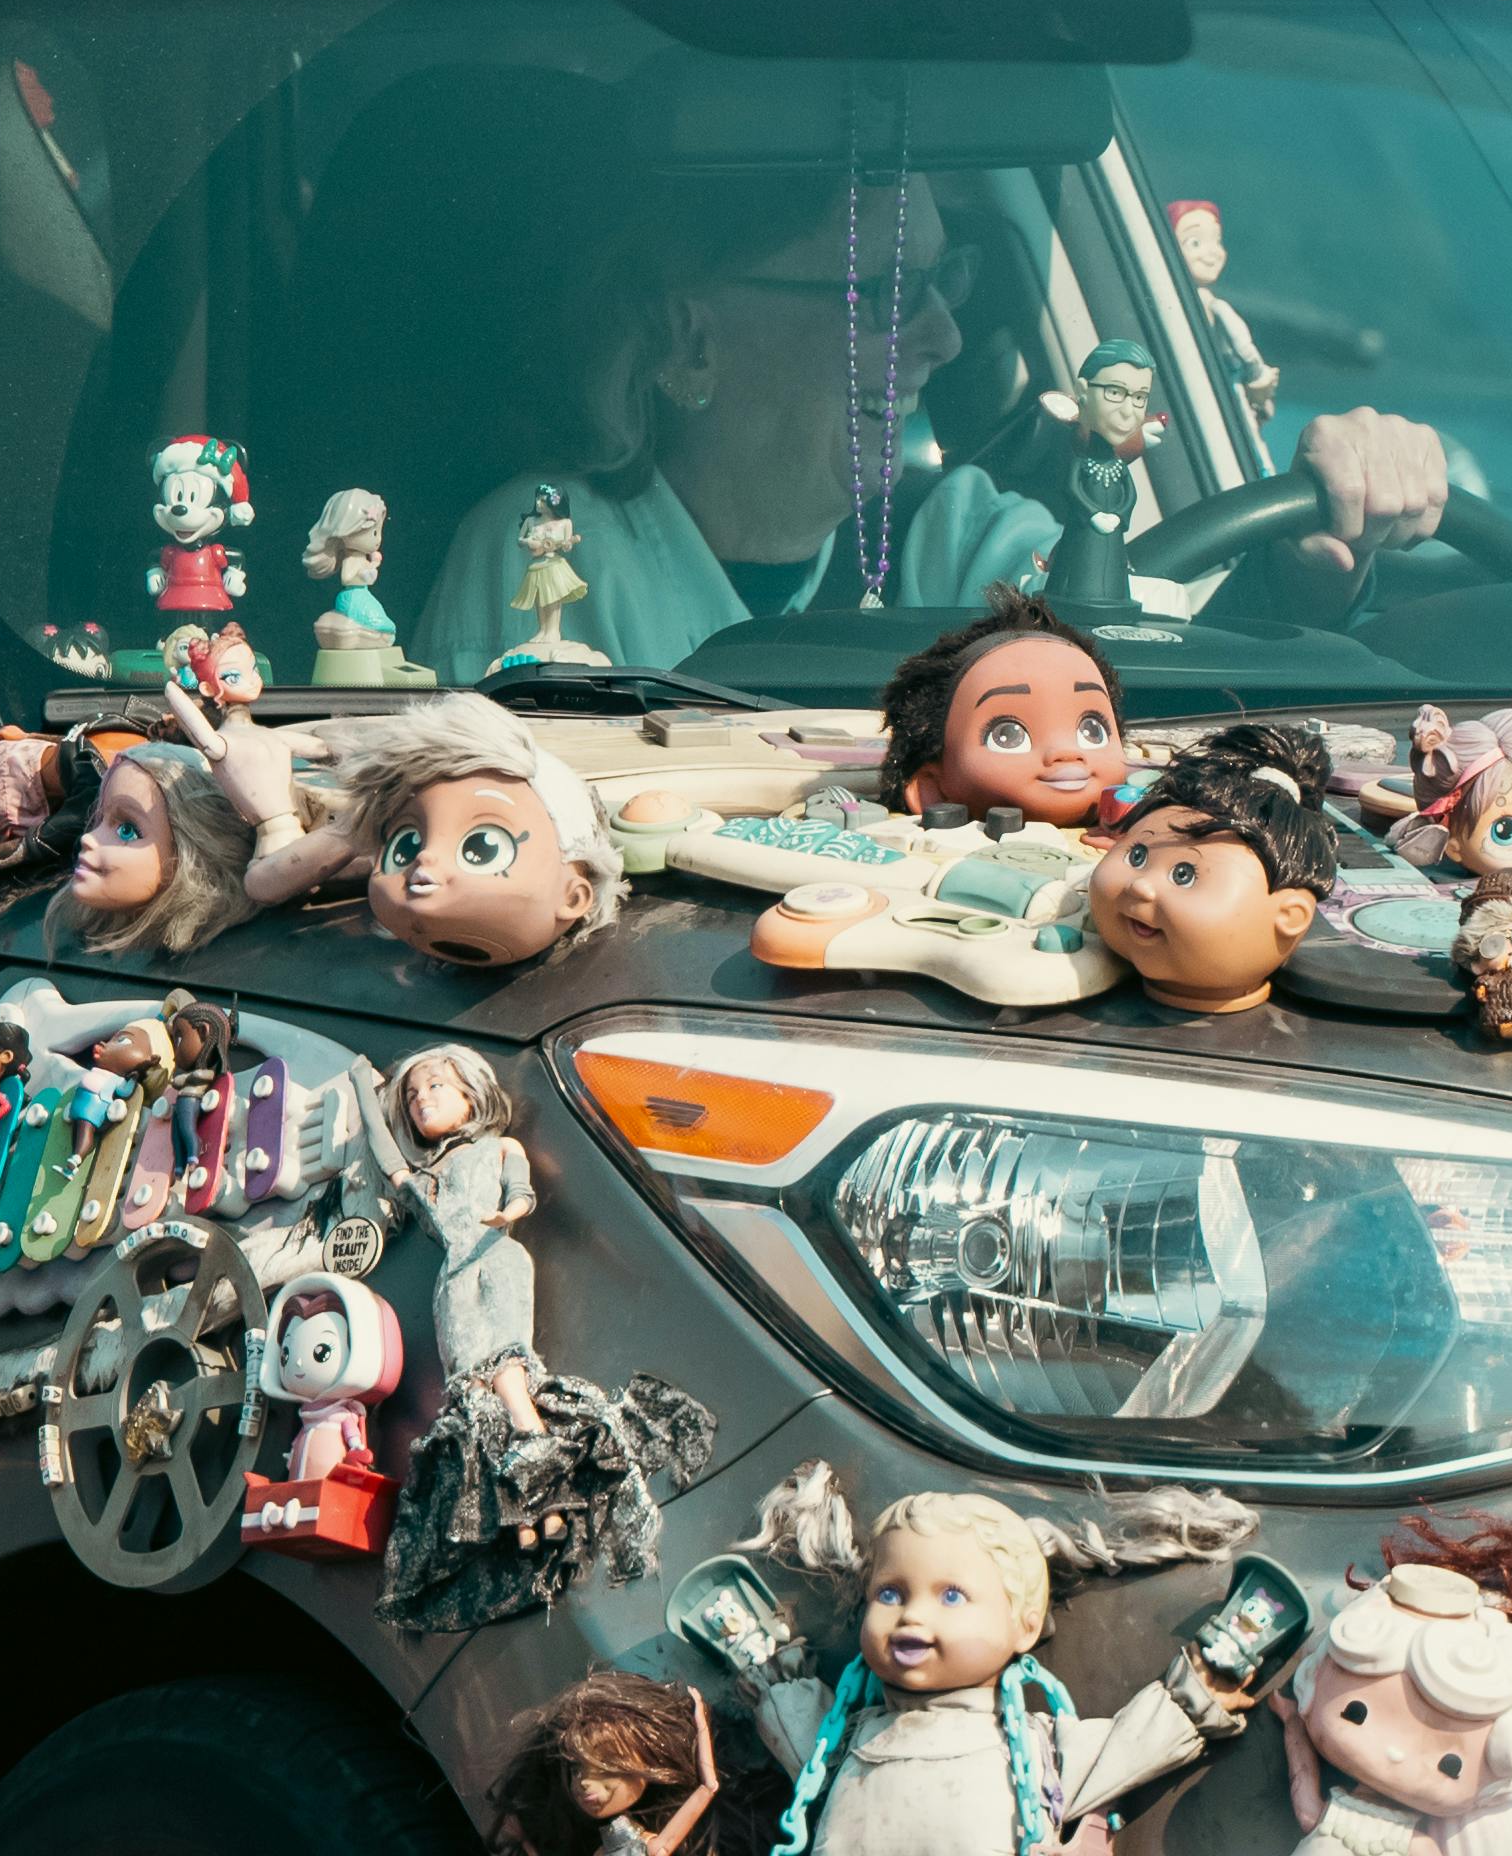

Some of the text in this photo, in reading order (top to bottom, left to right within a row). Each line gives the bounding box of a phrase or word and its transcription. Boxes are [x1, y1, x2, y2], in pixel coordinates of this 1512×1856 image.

[336, 1225, 370, 1241] FIND THE
[332, 1242, 368, 1258] BEAUTY
[333, 1258, 363, 1273] INSIDE!
